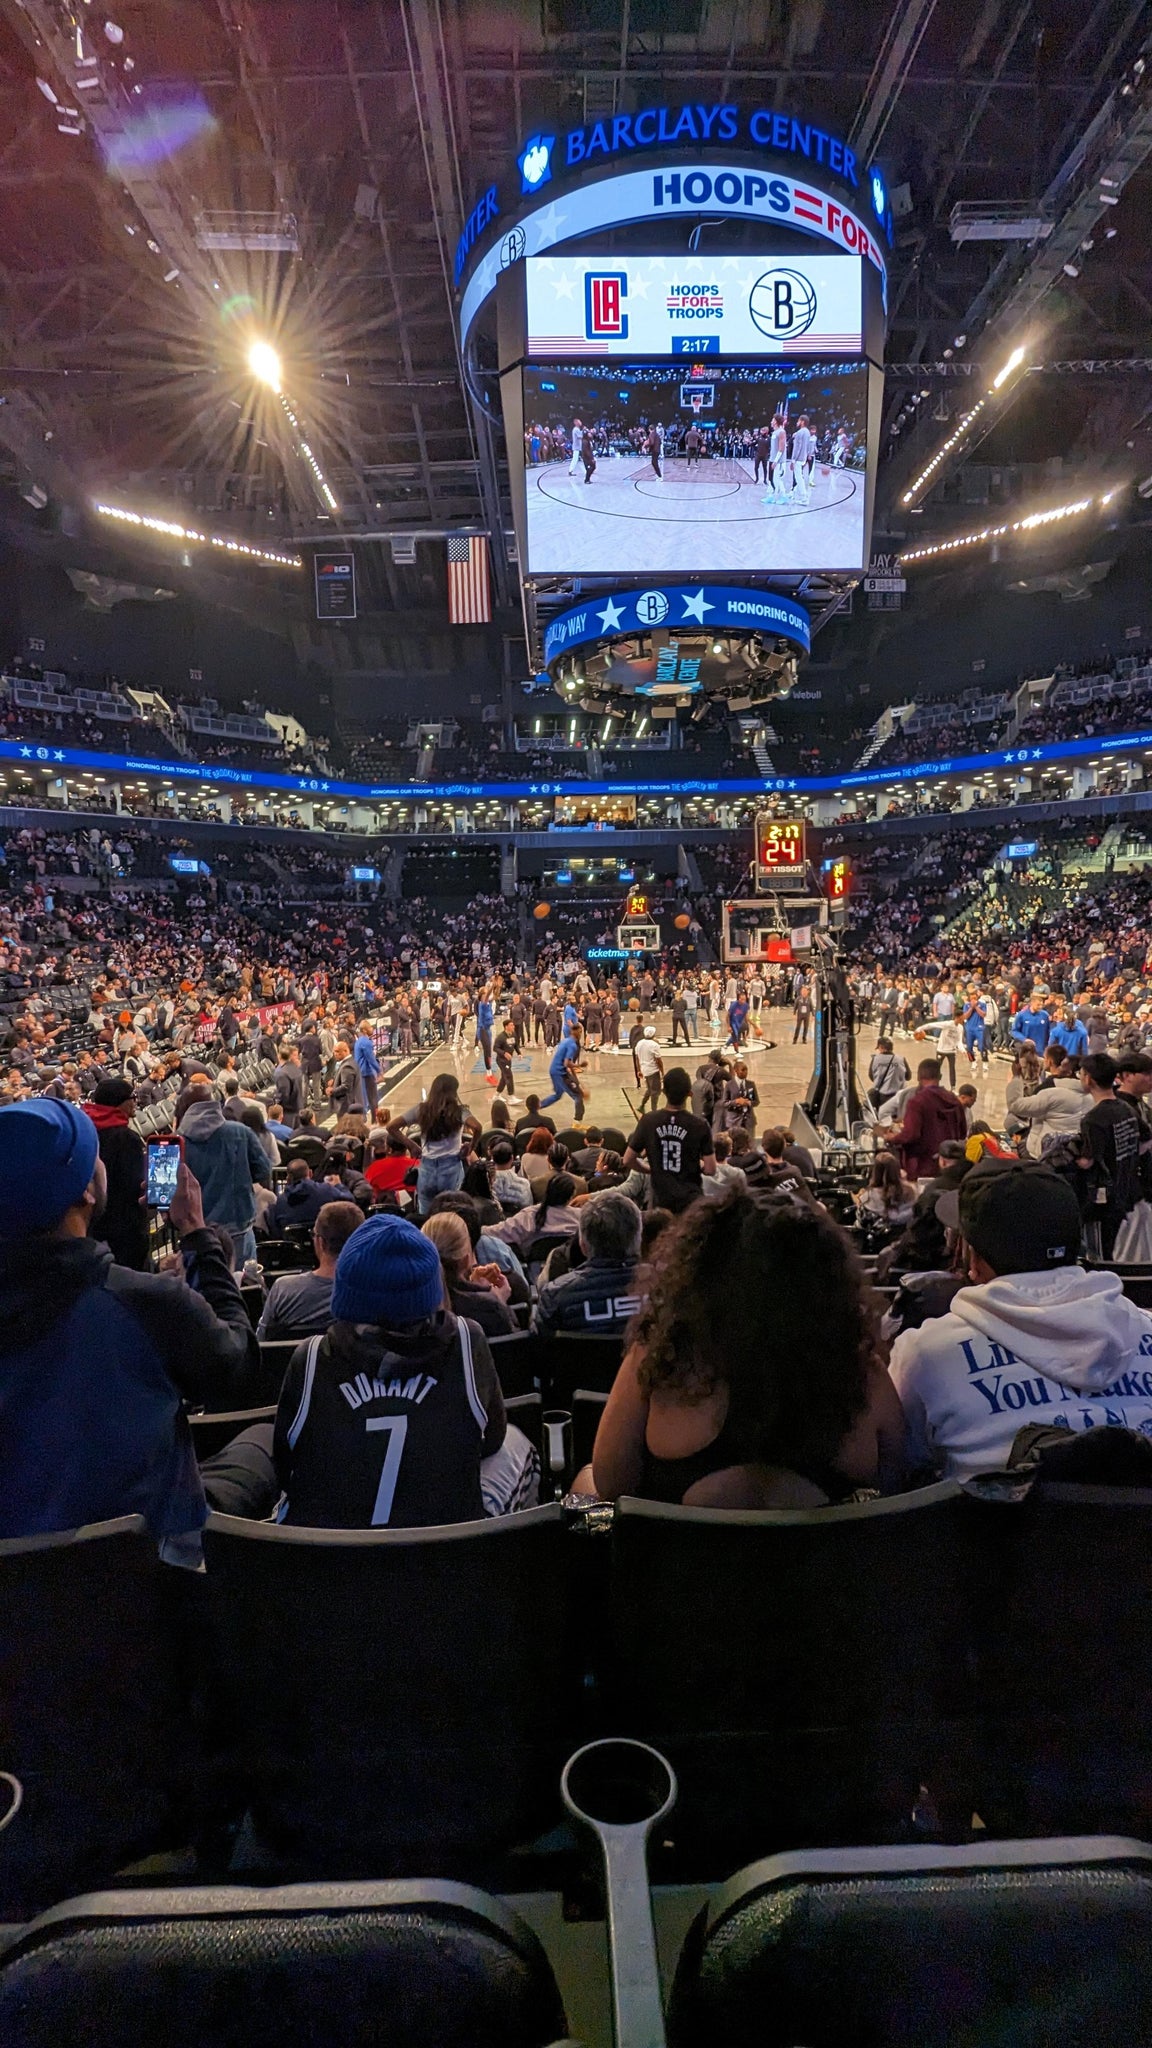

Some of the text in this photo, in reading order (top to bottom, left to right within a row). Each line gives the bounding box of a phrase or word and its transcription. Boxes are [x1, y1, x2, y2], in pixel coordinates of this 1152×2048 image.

[566, 106, 859, 187] BARCLAYS CENTER
[653, 172, 790, 212] HOOPS
[827, 202, 868, 255] FOR
[671, 285, 719, 296] HOOPS
[682, 296, 709, 307] FOR
[667, 308, 723, 319] TROOPS
[774, 281, 793, 329] B
[682, 339, 710, 352] 2:17
[870, 554, 890, 568] JAY
[647, 595, 657, 620] B
[728, 601, 787, 623] HONORING
[788, 613, 803, 631] OUR
[567, 612, 587, 637] WAY
[678, 658, 702, 681] CENTE
[1101, 738, 1140, 748] HONORING
[126, 761, 160, 771] HONORING
[176, 767, 200, 775] TROOPS
[201, 768, 212, 778] THE
[769, 825, 799, 839] 2:17
[766, 840, 796, 862] 24
[772, 865, 803, 873] TISSOT
[588, 948, 642, 958] ticketmasr
[661, 1140, 681, 1173] 13
[584, 1294, 649, 1321] US
[339, 1372, 438, 1410] DURANT
[969, 1374, 1051, 1415] You
[366, 1414, 408, 1526] 7
